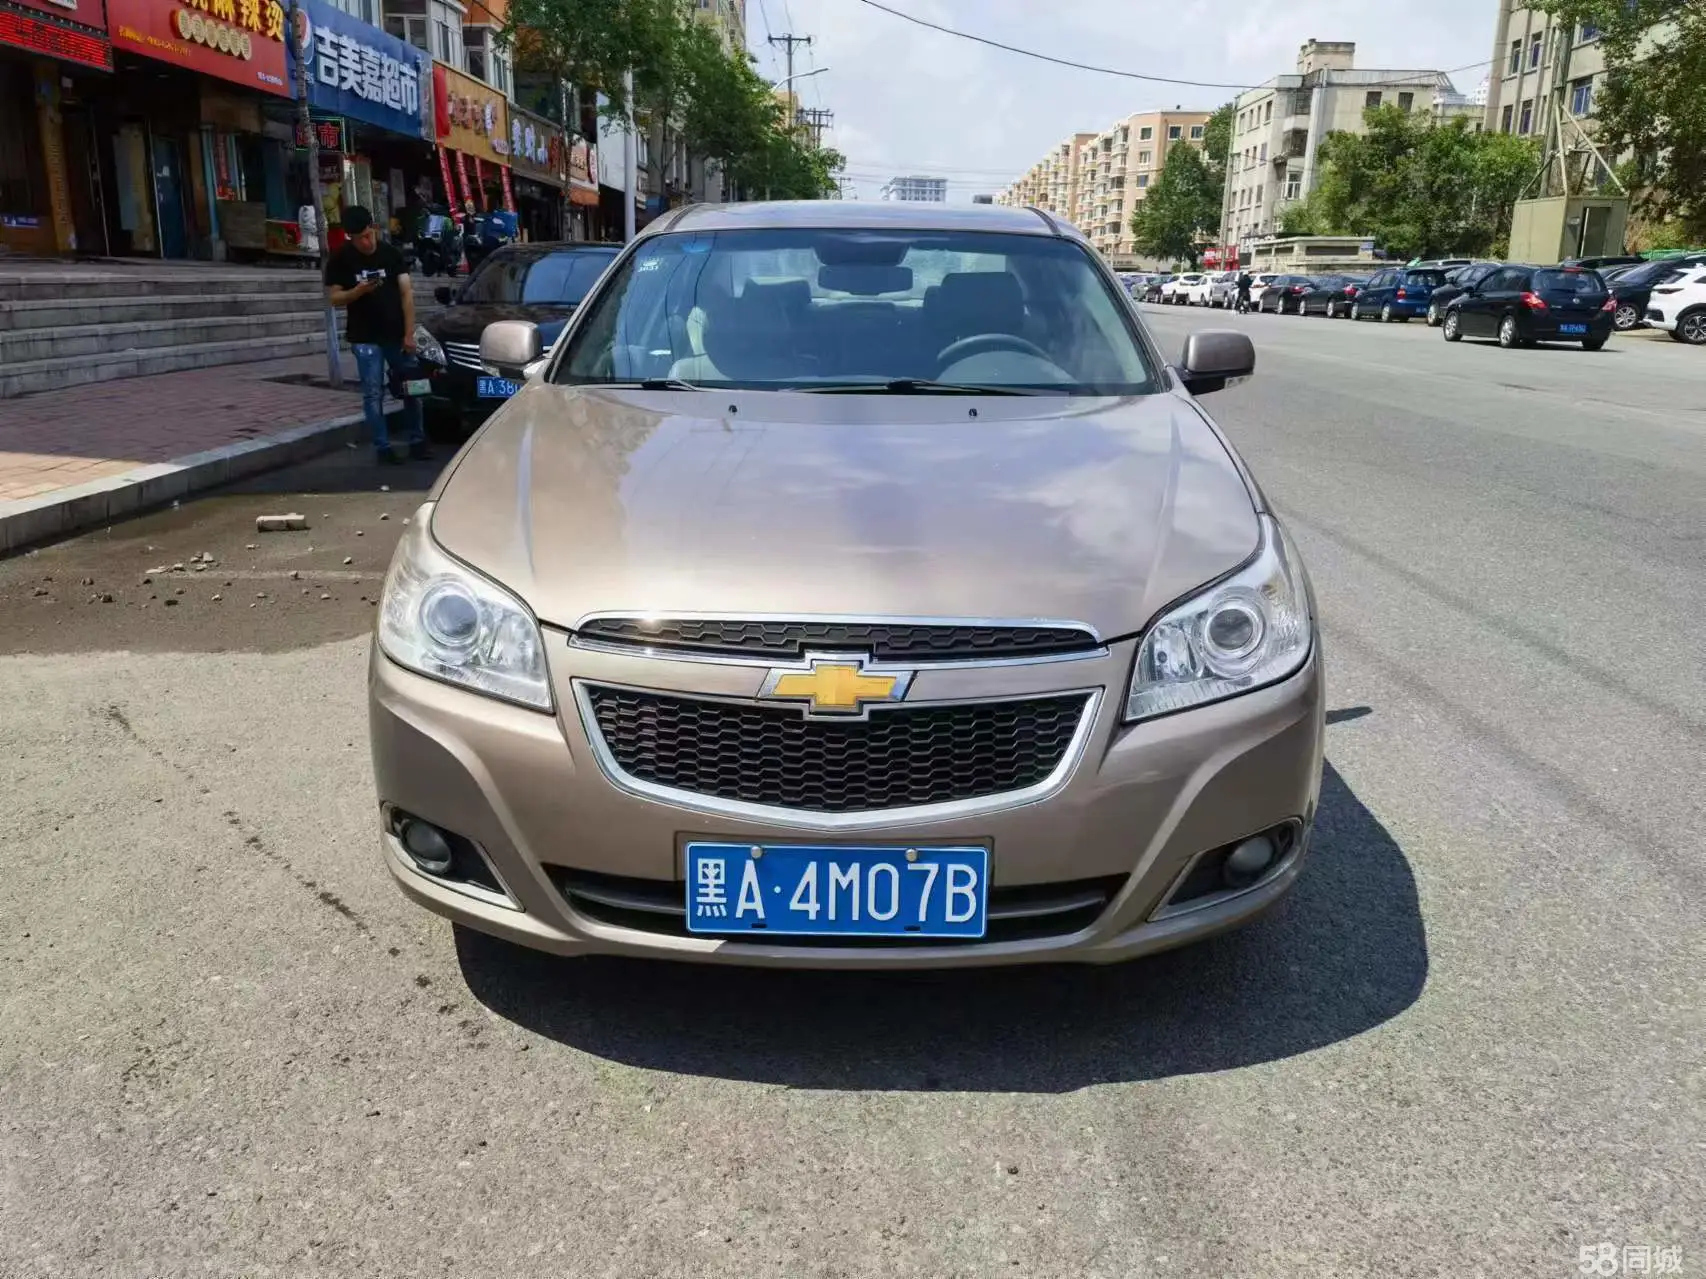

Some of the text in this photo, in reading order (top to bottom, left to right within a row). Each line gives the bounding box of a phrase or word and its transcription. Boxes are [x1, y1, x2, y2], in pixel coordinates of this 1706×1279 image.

[315, 25, 418, 115] 吉美嘉超市
[695, 857, 979, 924] 黑A·4M07B
